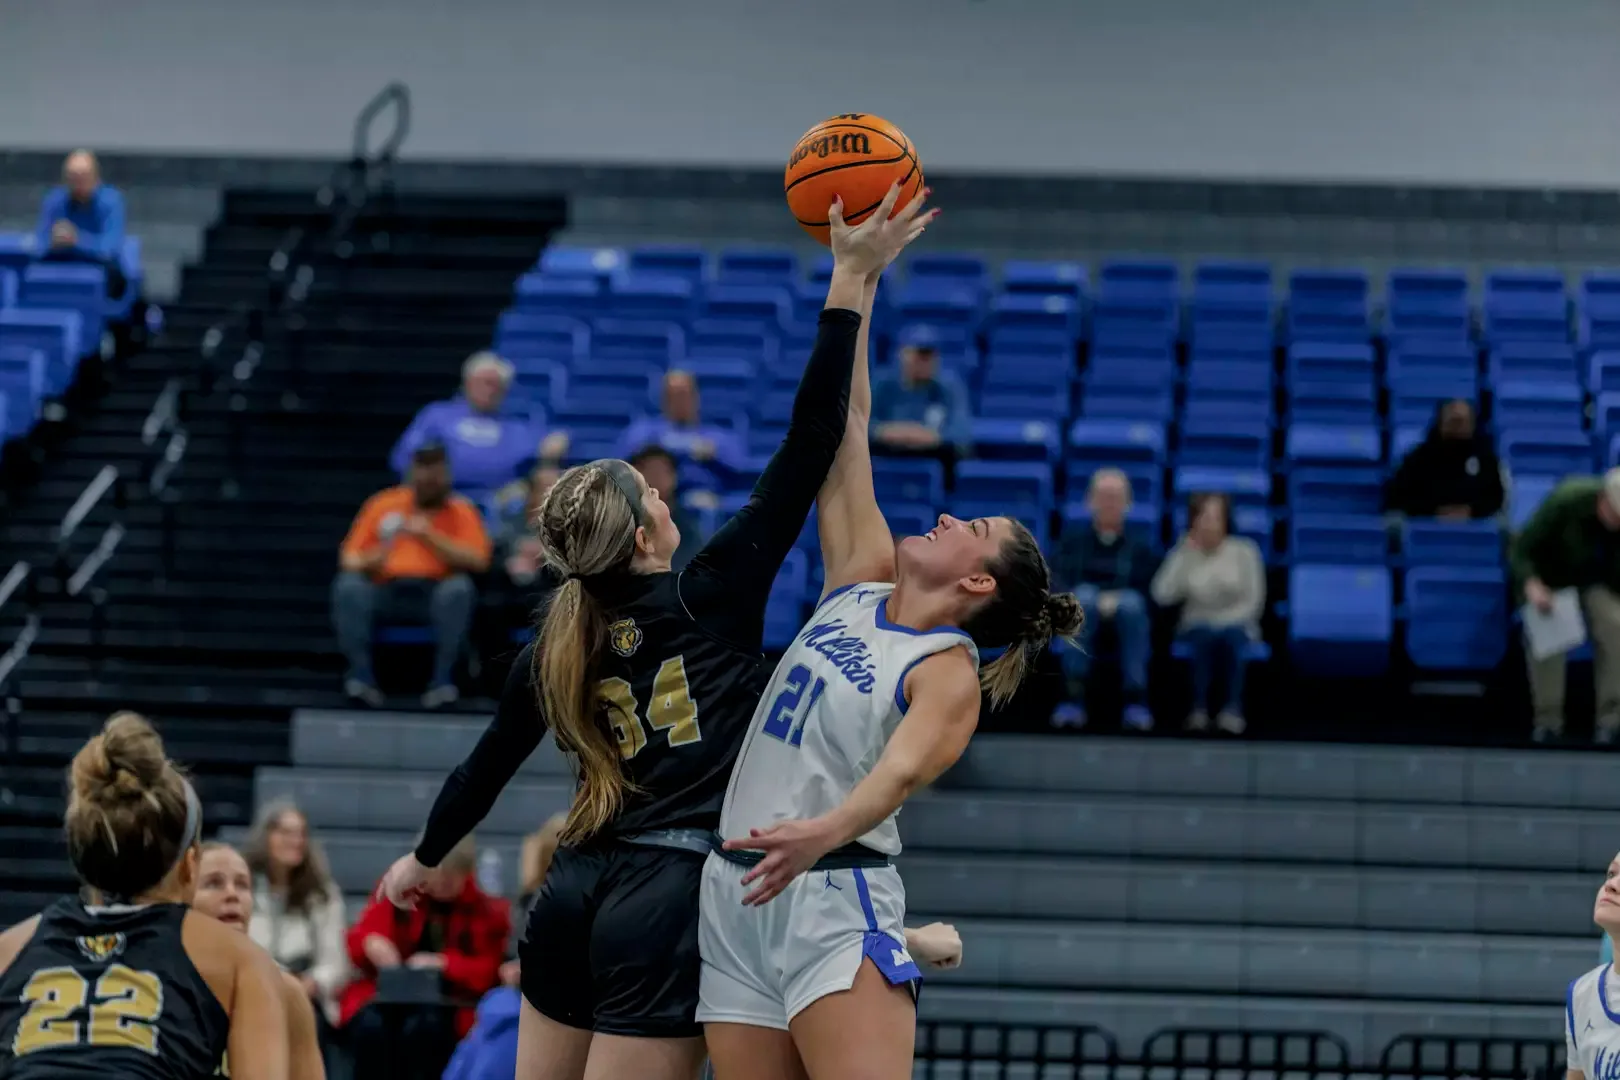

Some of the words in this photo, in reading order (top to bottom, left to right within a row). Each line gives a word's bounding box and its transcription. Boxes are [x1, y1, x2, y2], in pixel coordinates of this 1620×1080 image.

[789, 132, 872, 169] Wilson
[598, 654, 702, 760] 34
[762, 663, 828, 749] 21
[12, 963, 164, 1057] 22
